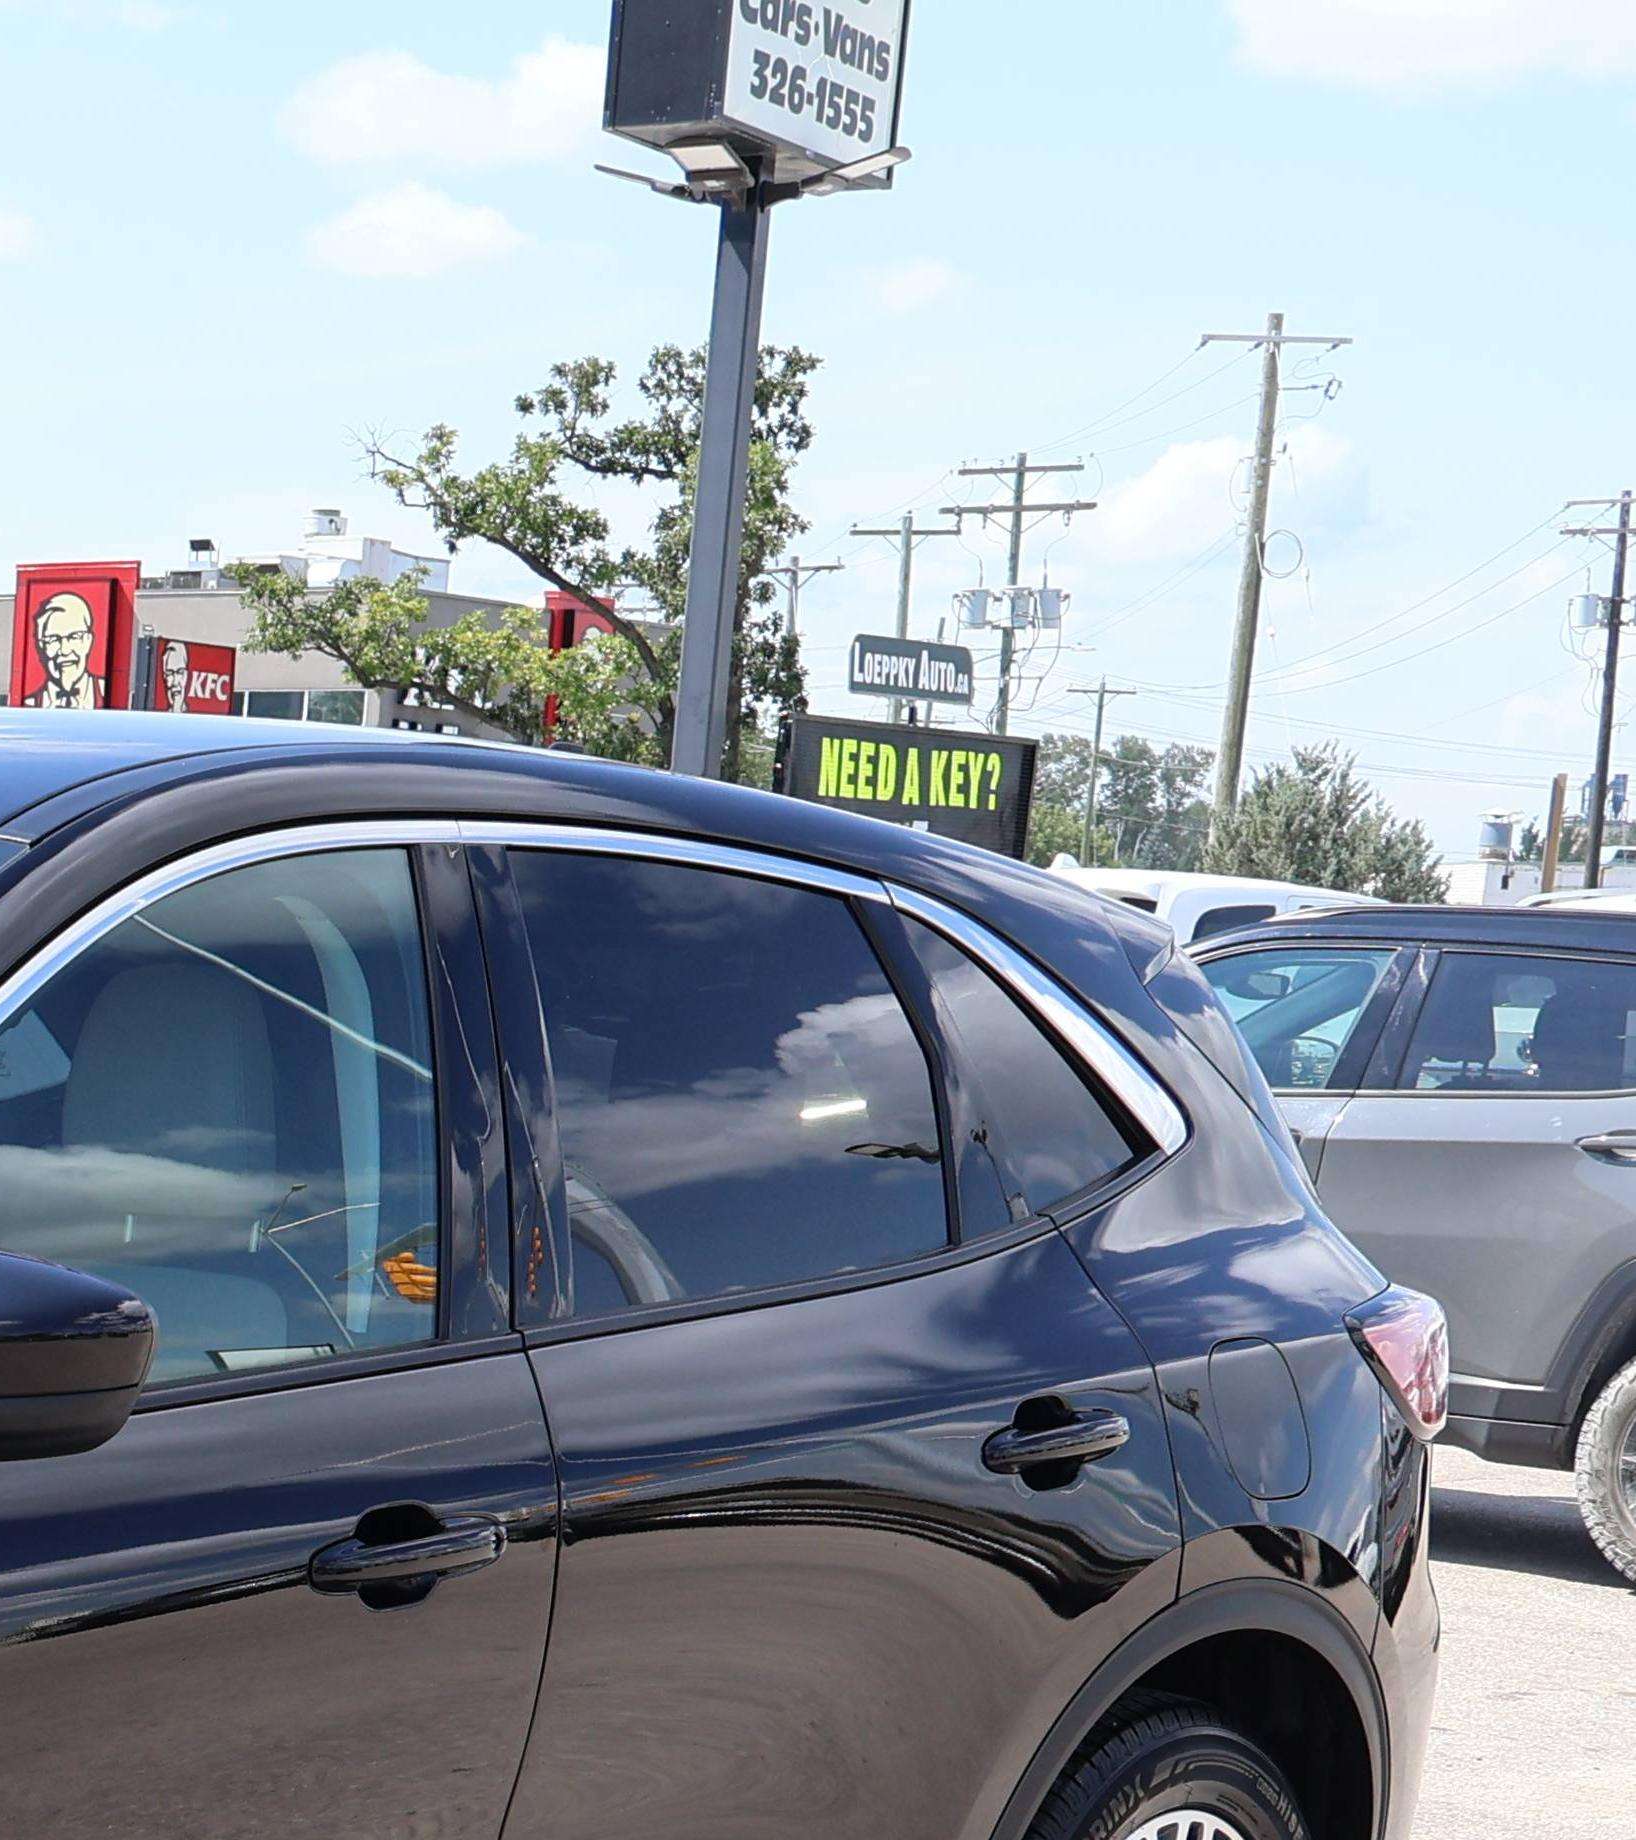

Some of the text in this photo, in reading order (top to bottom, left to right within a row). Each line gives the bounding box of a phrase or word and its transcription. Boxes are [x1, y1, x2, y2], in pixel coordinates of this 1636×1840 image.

[750, 49, 876, 143] 326-1555
[188, 670, 230, 701] KFC
[853, 641, 916, 688] LOEPPKY
[817, 737, 1002, 810] NEED A KEY?
